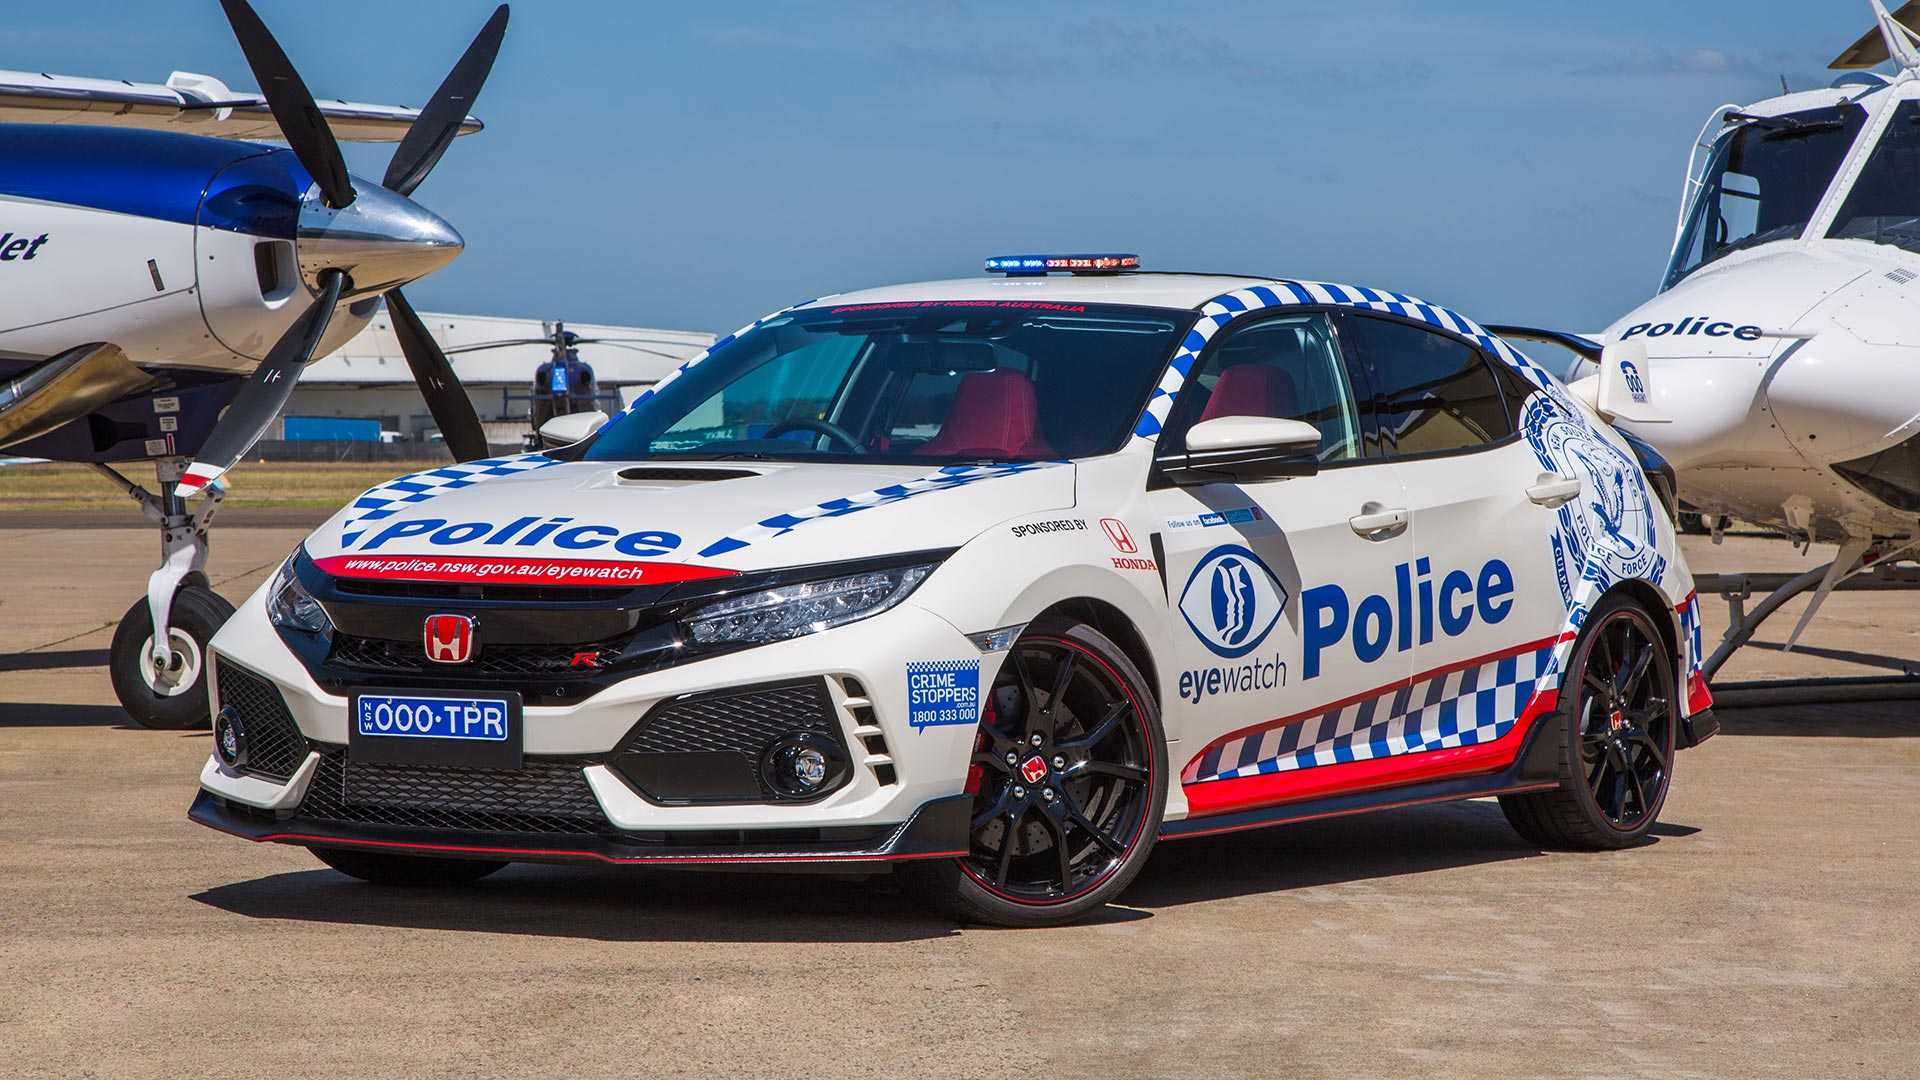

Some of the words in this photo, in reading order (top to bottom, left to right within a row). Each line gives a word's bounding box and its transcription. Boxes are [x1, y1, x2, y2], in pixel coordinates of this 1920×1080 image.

[998, 301, 1085, 312] AUSTRALIA
[1011, 519, 1075, 538] SPONSORED
[1074, 518, 1089, 530] BY
[1576, 514, 1613, 565] POLICE
[1621, 553, 1648, 575] FORCE
[344, 558, 645, 580] www.police.nsw.gov.au/eyewatch
[1111, 557, 1158, 571] HONDA
[1301, 554, 1515, 681] Police
[911, 673, 956, 689] CRIME
[1178, 653, 1288, 705] eyewatch
[912, 687, 977, 704] STOPPERS
[912, 710, 937, 723] 1800
[939, 709, 957, 721] 333
[959, 708, 976, 720] 000
